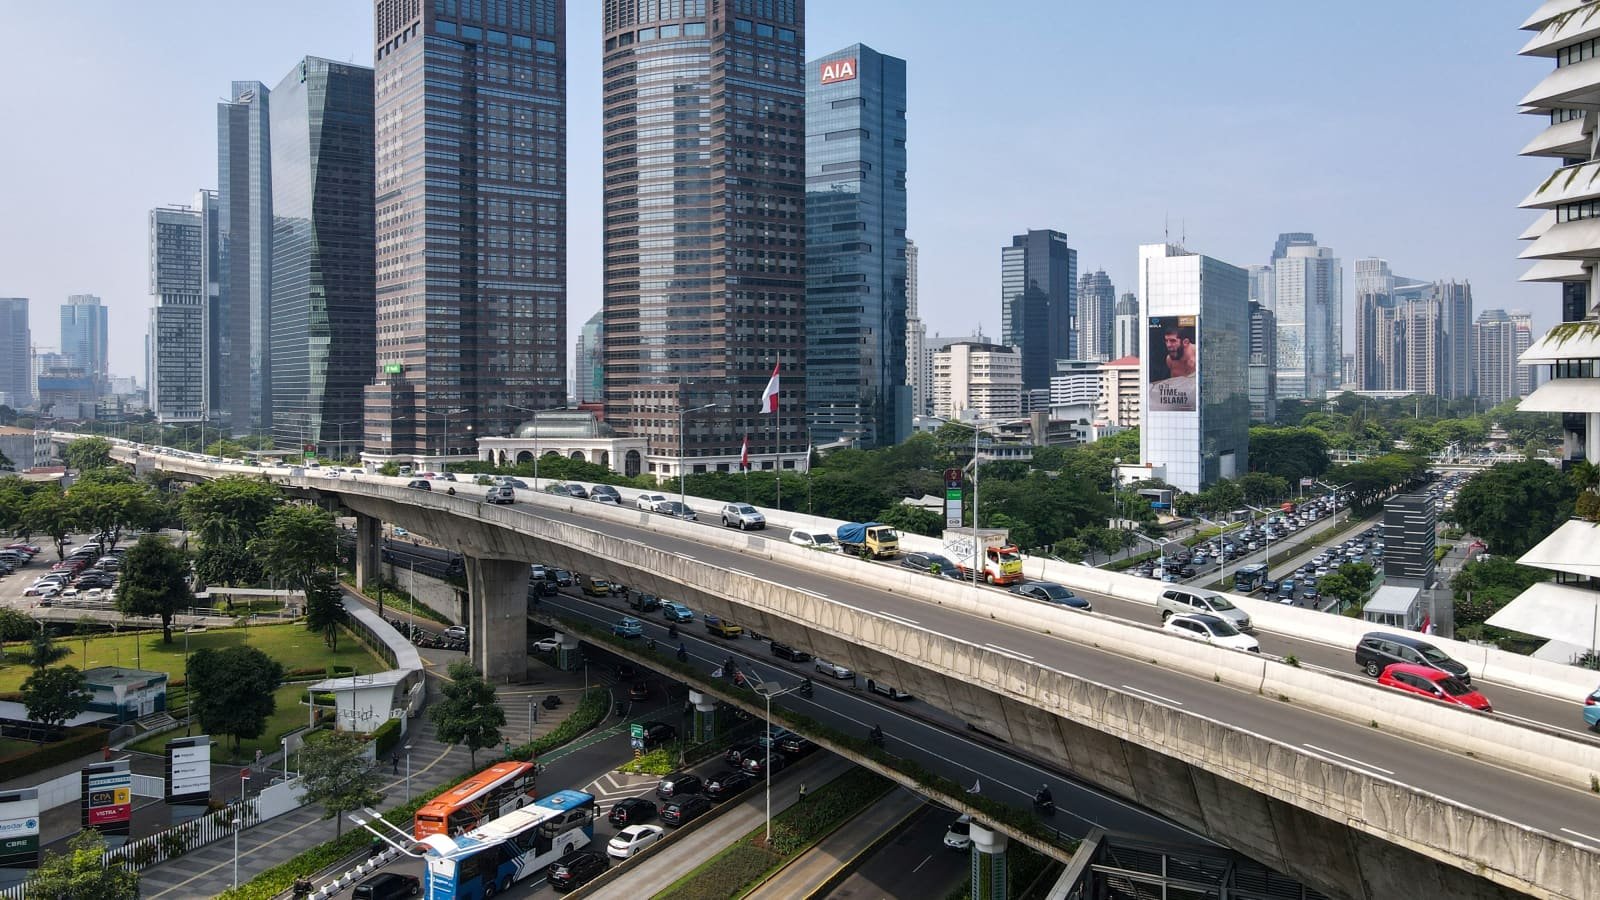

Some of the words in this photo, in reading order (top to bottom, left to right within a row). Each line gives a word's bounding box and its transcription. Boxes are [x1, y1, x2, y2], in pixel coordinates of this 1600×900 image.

[822, 62, 854, 80] AIA
[1160, 388, 1177, 396] TIME
[1160, 396, 1188, 404] ISLAM?
[93, 793, 111, 801] CPA
